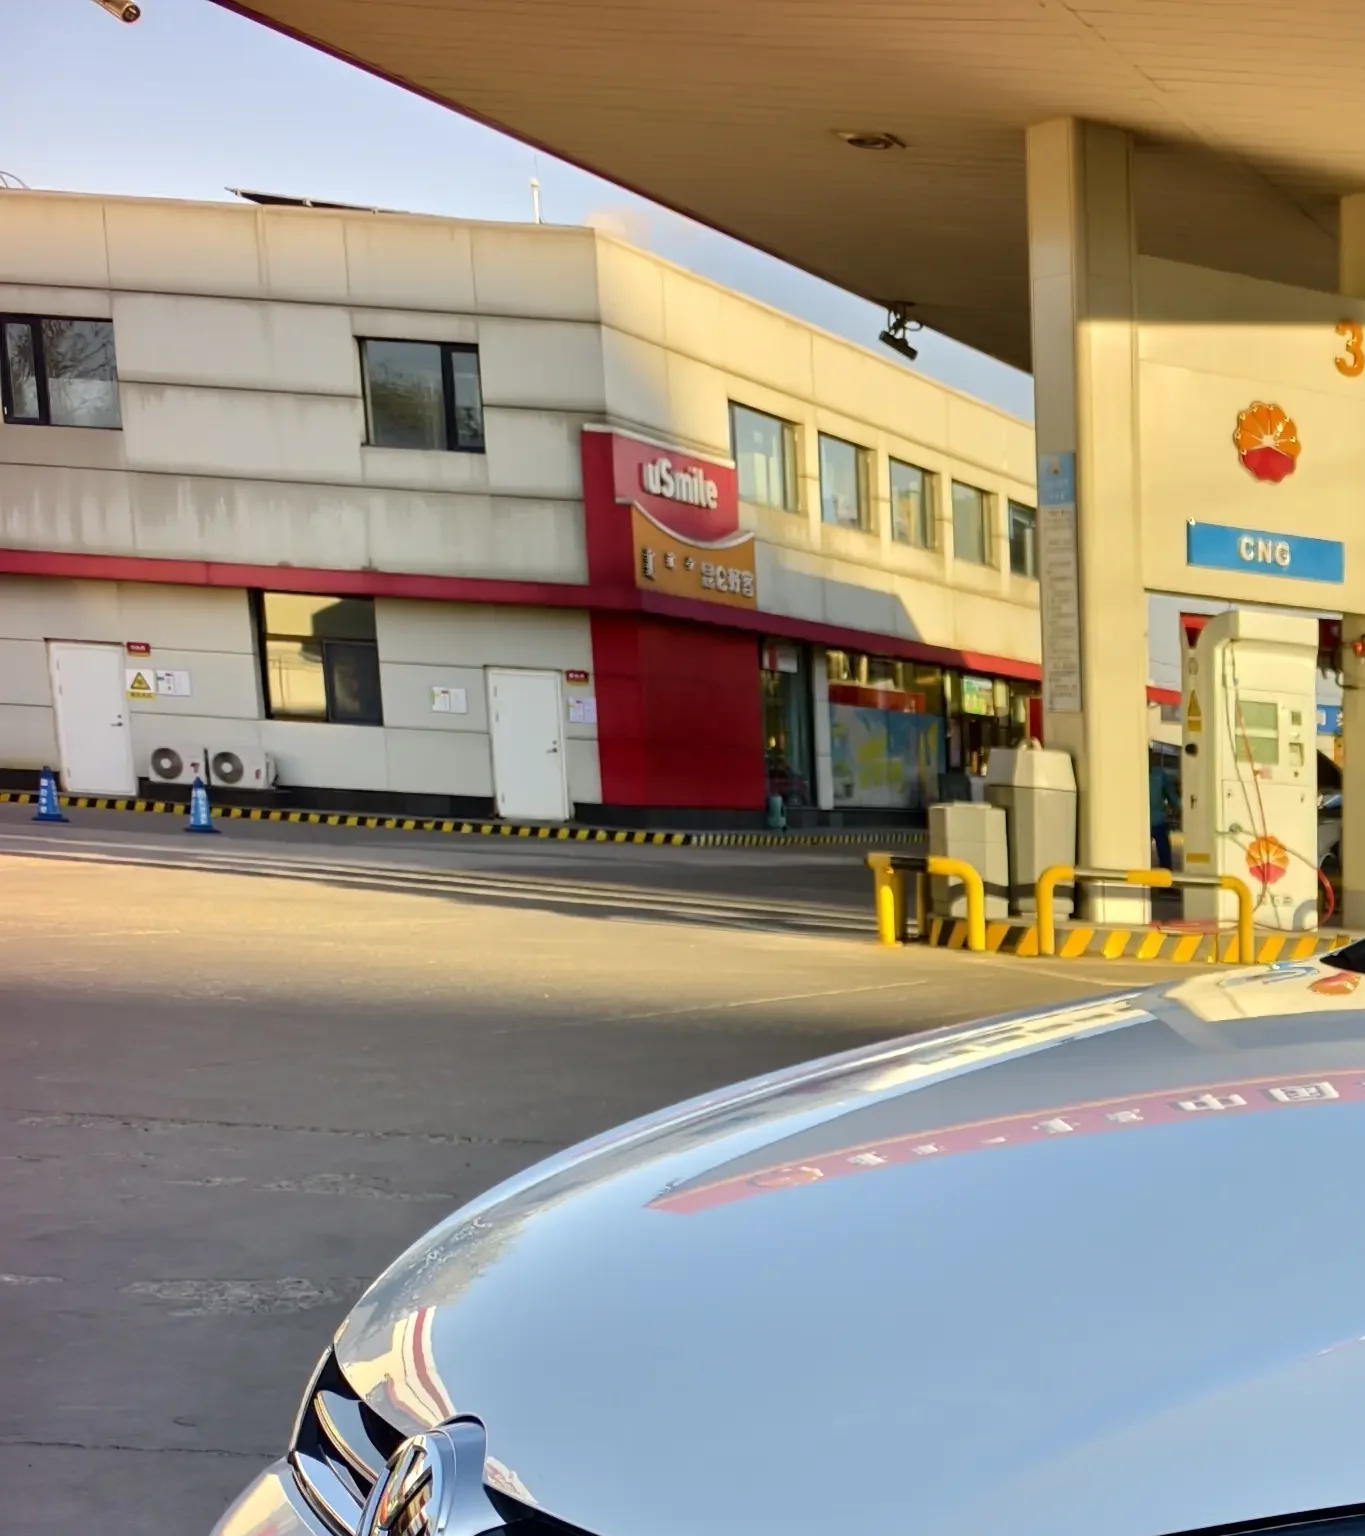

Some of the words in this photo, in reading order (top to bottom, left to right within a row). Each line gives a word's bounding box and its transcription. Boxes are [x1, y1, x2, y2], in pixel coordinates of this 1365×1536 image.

[1334, 319, 1365, 377] 3
[641, 457, 718, 510] uSmile
[1237, 535, 1292, 567] CNG
